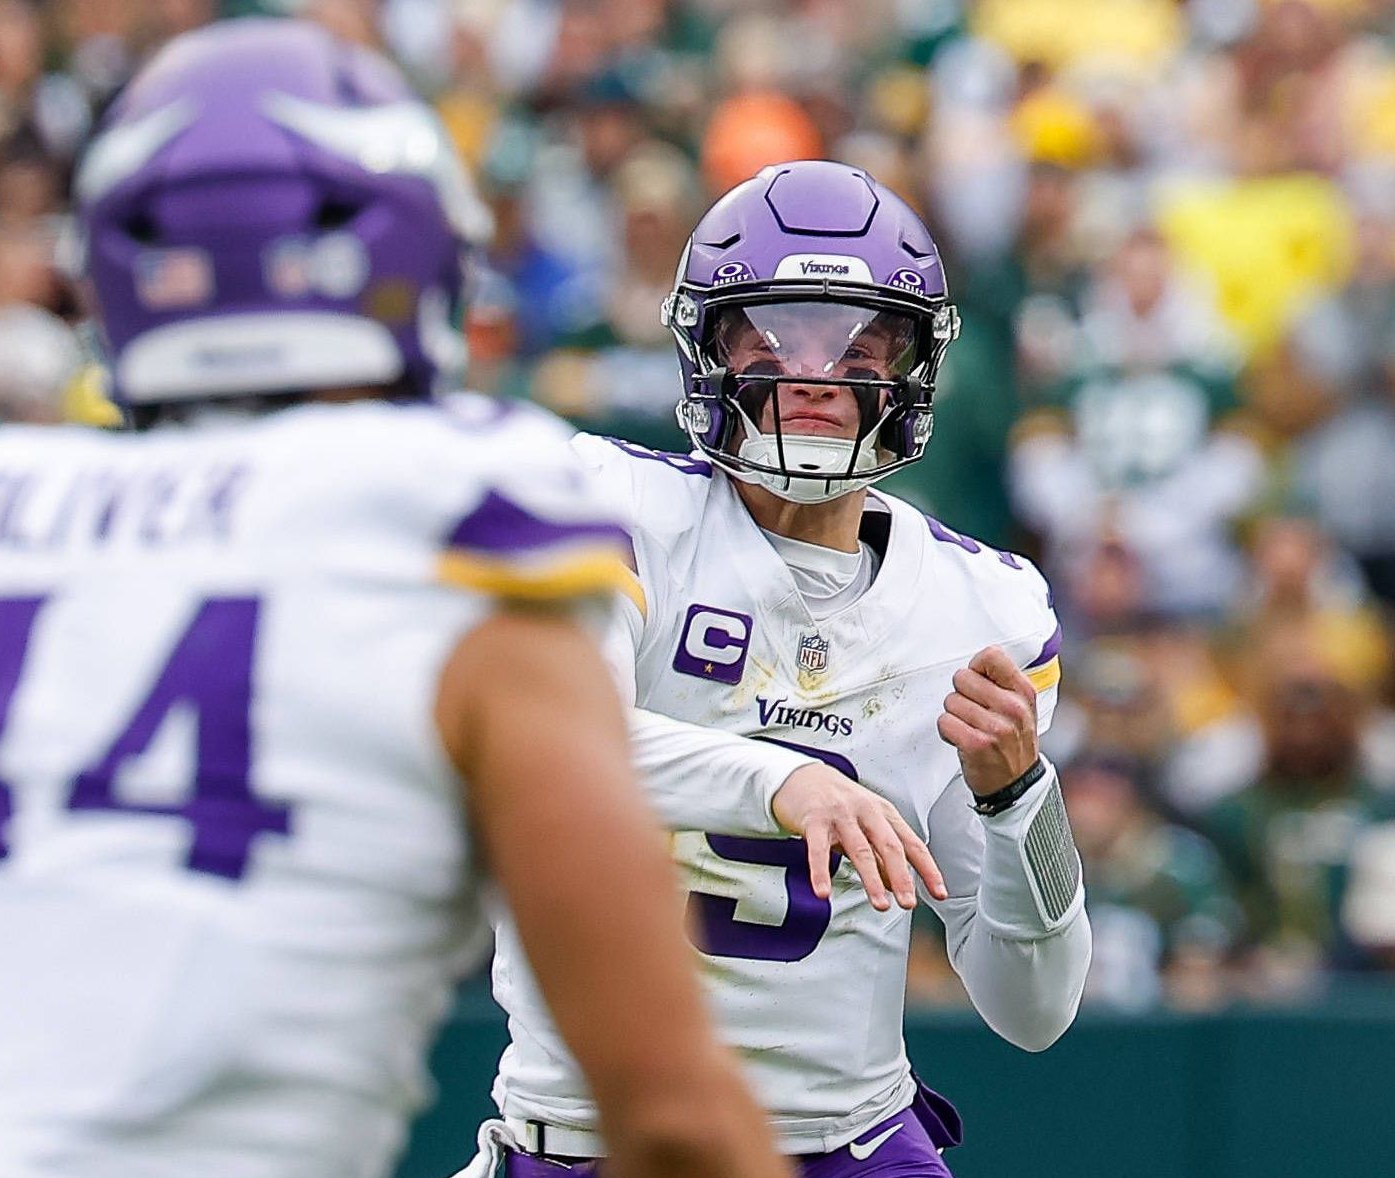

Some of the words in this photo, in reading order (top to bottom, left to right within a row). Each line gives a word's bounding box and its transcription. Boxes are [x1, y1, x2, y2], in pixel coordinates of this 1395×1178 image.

[713, 273, 749, 287] OAKLEY
[685, 611, 746, 665] C
[802, 649, 824, 668] NFL
